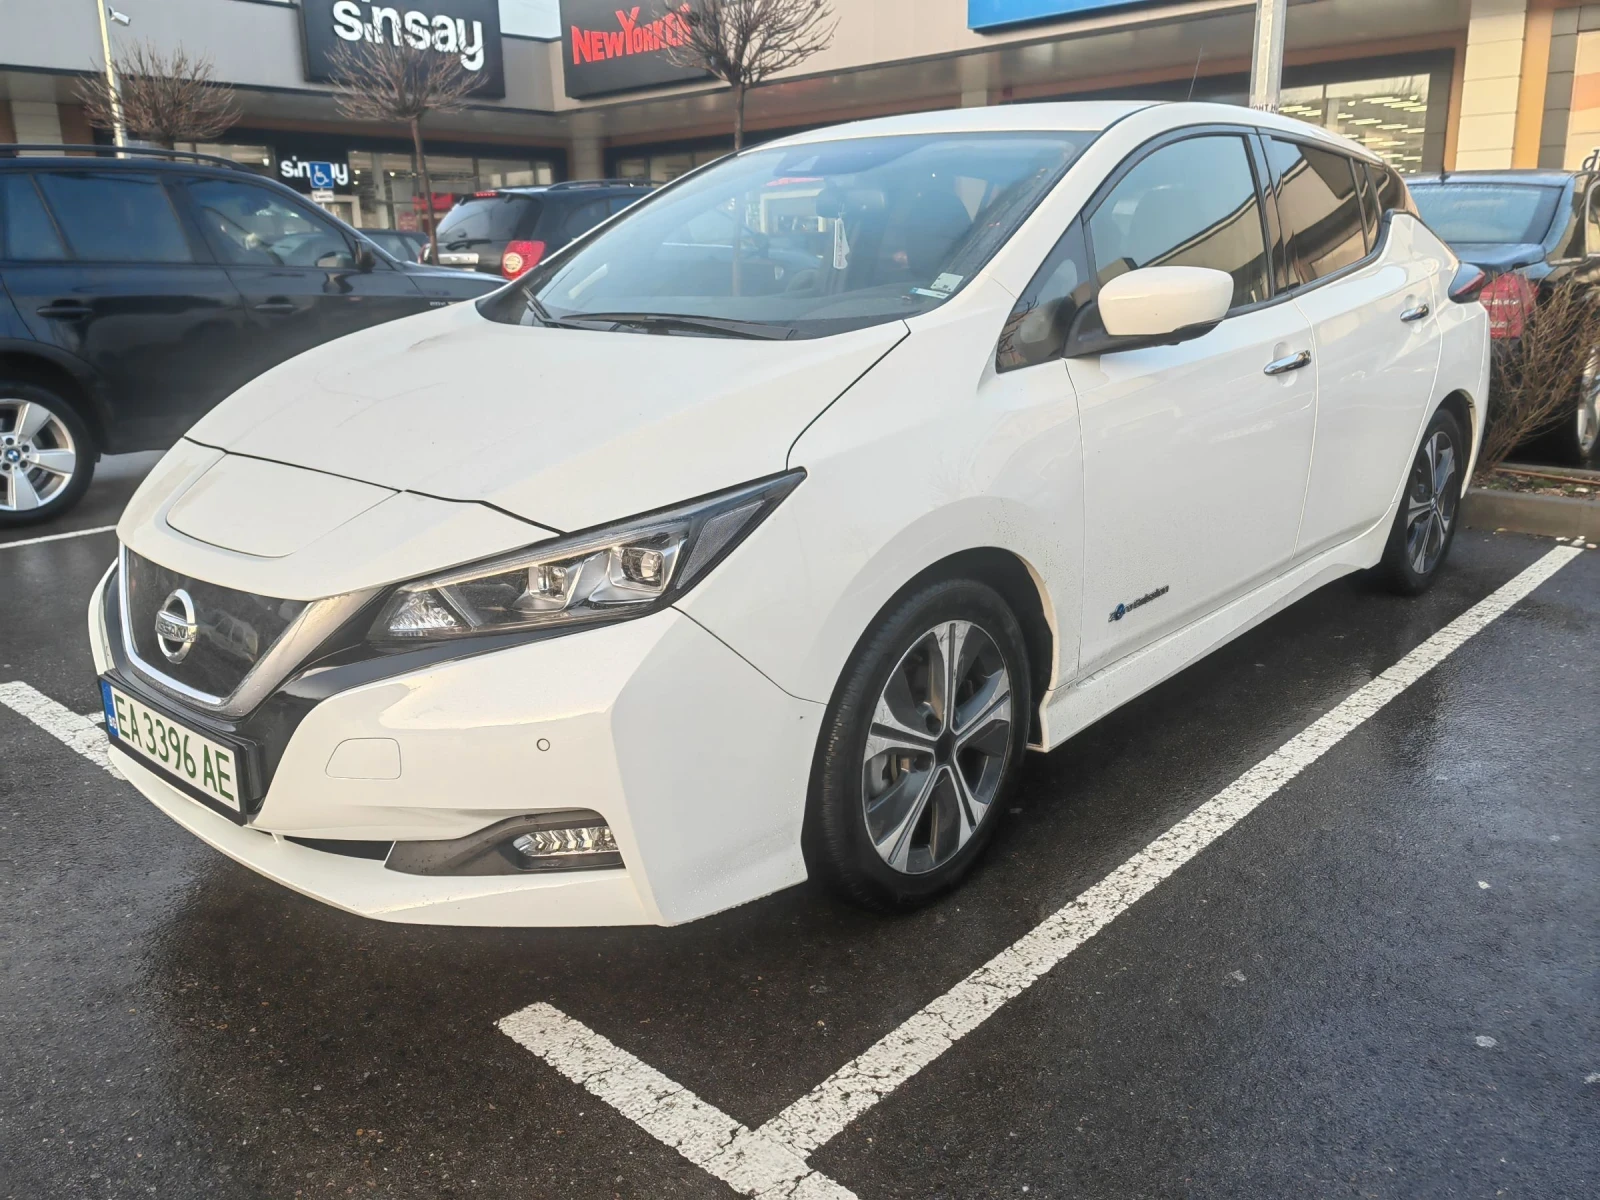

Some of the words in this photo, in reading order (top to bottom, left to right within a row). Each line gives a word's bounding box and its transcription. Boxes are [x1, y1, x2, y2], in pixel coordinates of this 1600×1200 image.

[333, 0, 485, 71] sinsay
[281, 155, 349, 185] siny
[157, 617, 188, 639] SSAN
[113, 693, 142, 748] EA
[143, 711, 197, 779] 3396
[203, 743, 235, 801] AE
